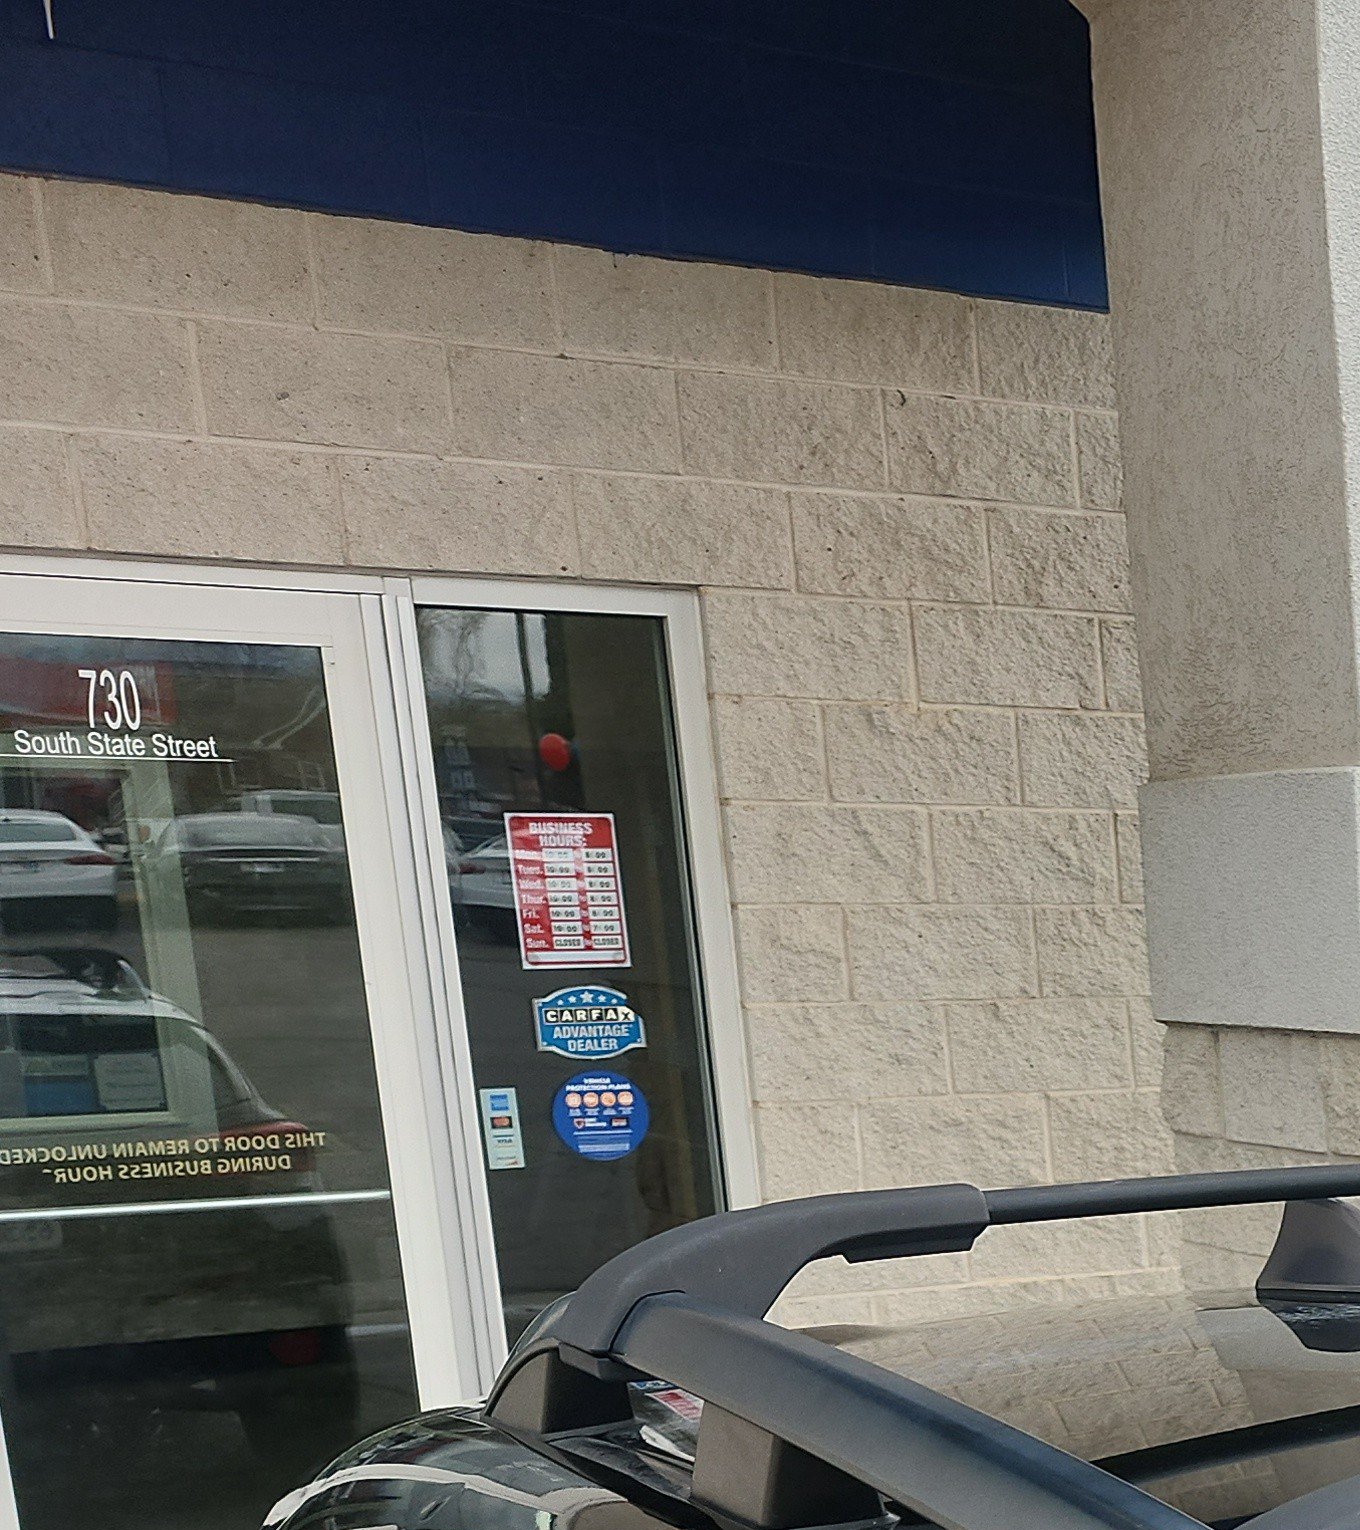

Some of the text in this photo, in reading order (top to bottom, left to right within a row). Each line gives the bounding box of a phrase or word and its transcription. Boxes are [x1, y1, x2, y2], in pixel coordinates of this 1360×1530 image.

[78, 669, 141, 731] 730
[14, 730, 219, 758] South State Street
[528, 821, 593, 835] BUSINESS
[539, 835, 588, 847] HOURS:
[545, 1008, 632, 1022] CARFAX
[552, 1024, 630, 1038] ADVANTAGE
[567, 1039, 618, 1051] DEALER
